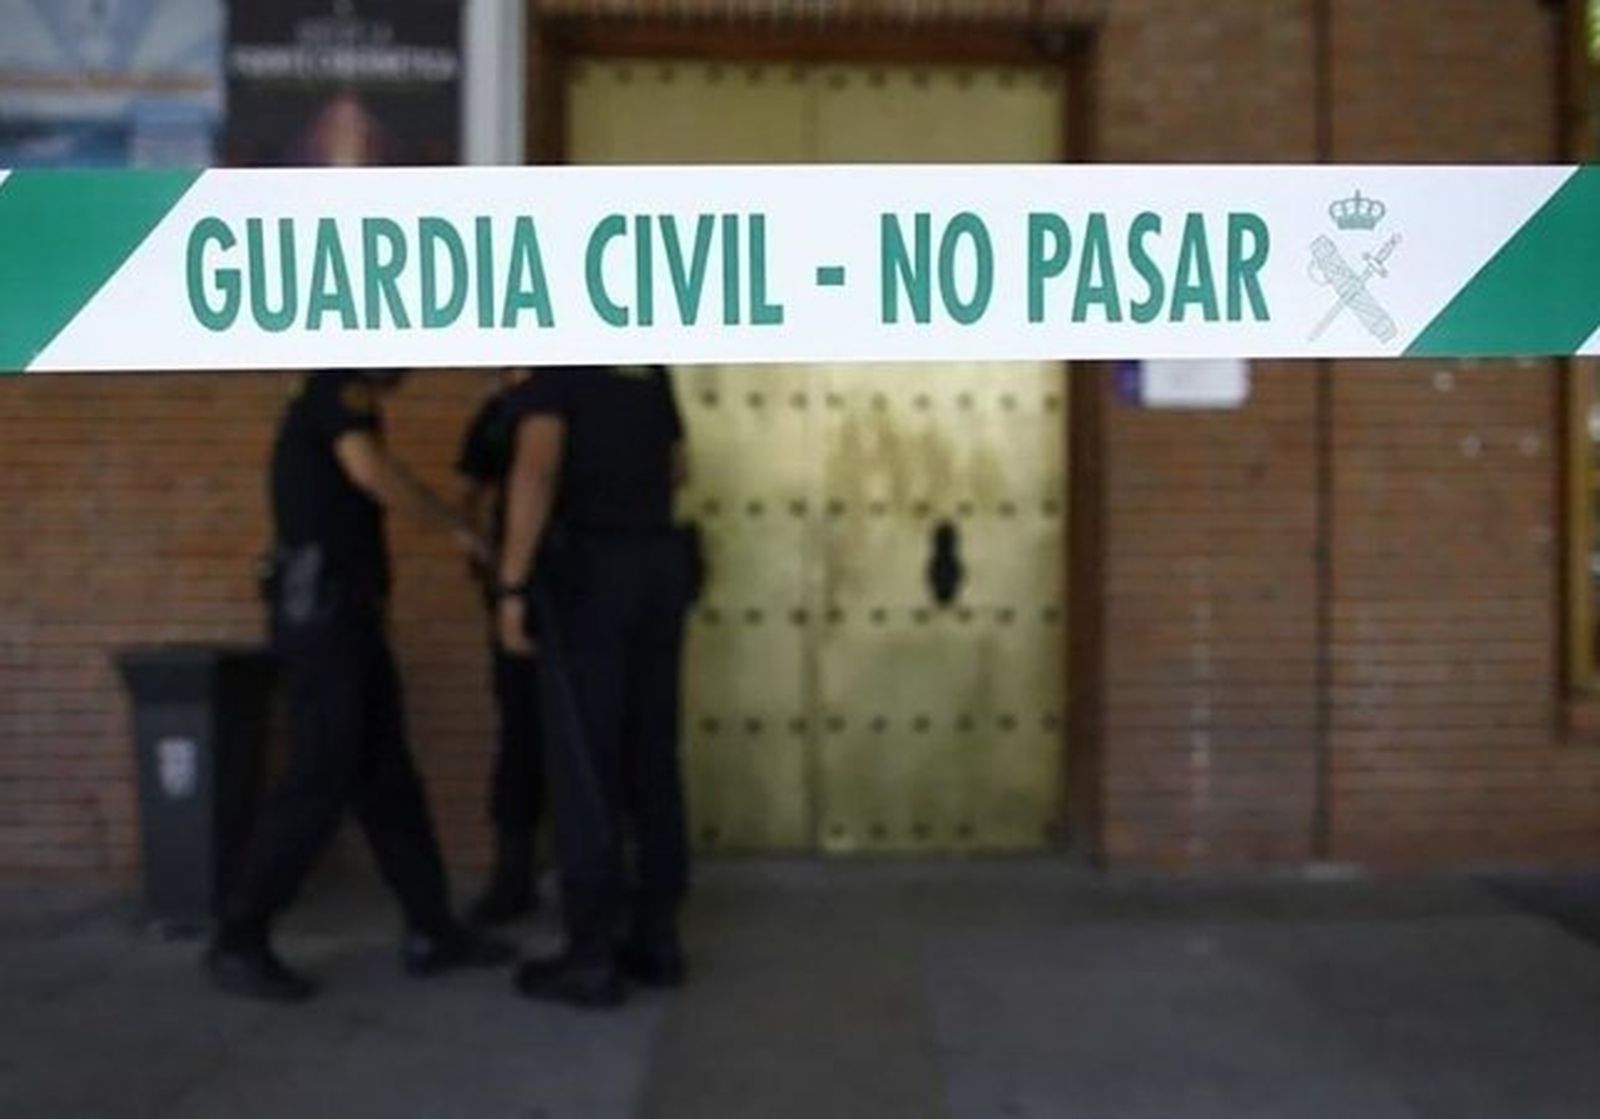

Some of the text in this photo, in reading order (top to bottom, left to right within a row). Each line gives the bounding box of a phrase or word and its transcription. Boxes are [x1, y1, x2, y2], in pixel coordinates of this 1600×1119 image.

[186, 211, 1271, 332] GUARDIA CIVIL - NO PASAR
